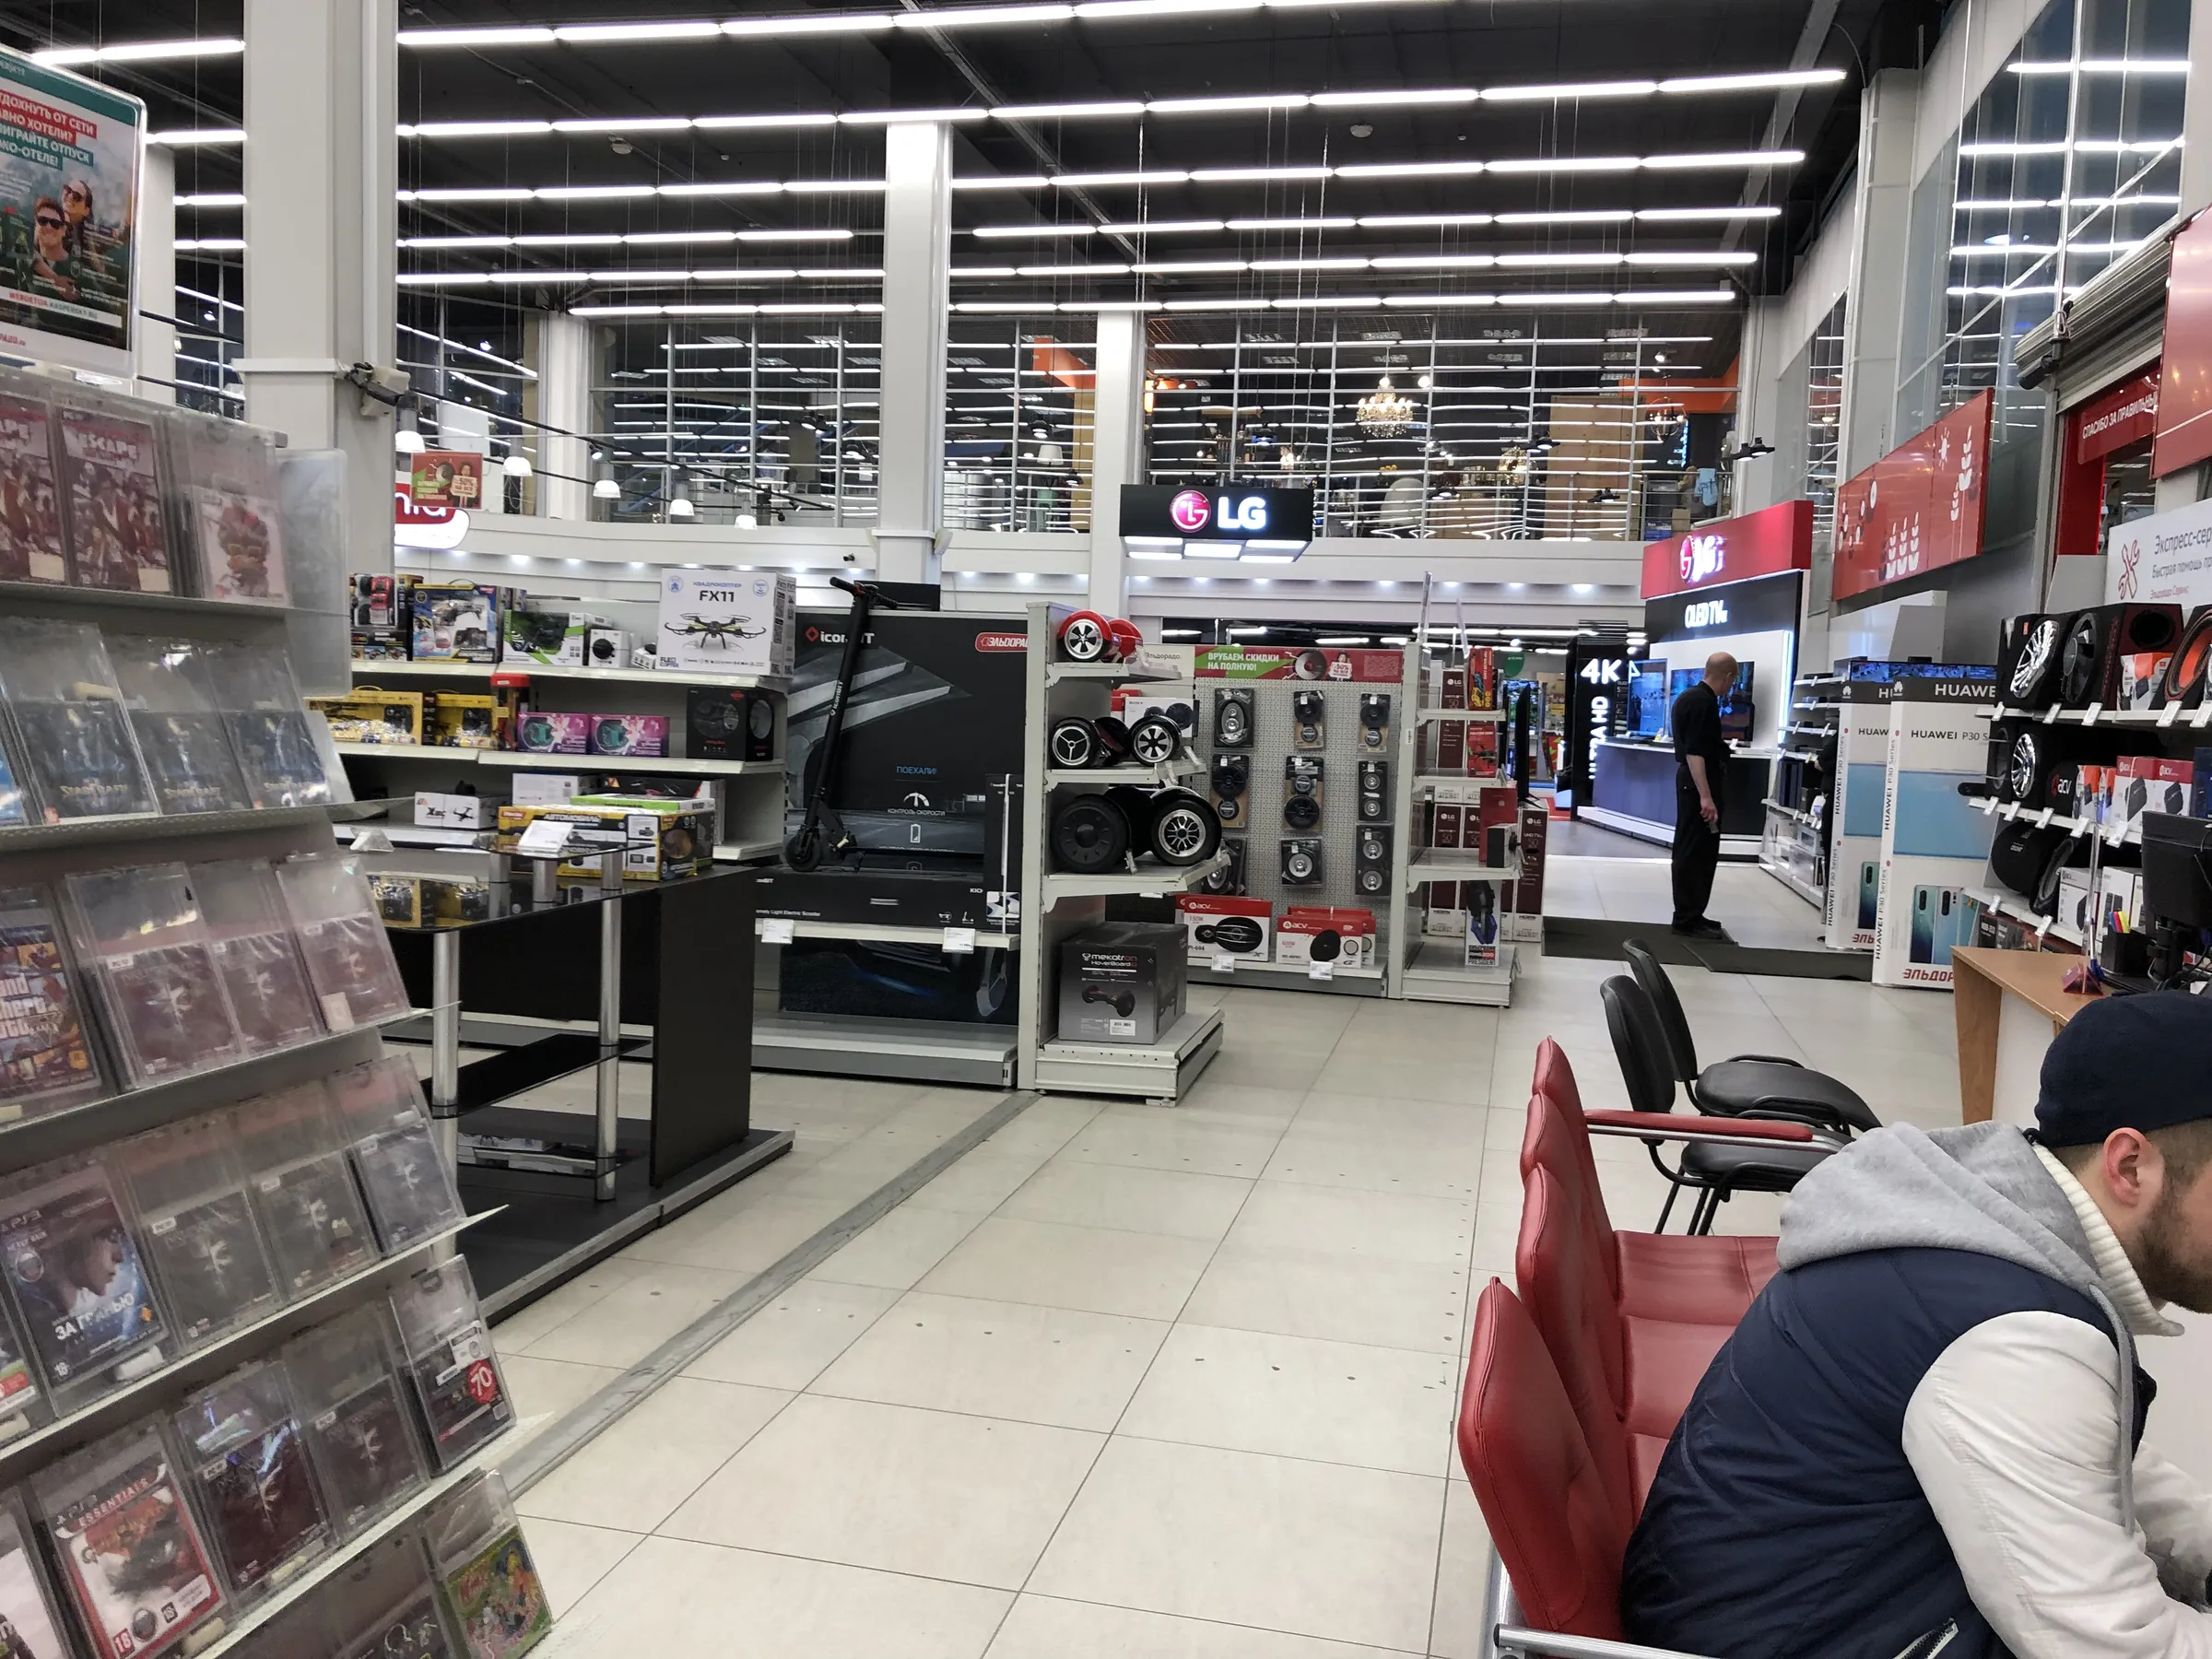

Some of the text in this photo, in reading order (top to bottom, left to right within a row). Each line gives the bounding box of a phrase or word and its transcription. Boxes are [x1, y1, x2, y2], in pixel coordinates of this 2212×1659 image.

[28, 120, 73, 142] ХОТЕЛИ?
[53, 112, 67, 124] ОТ
[69, 118, 93, 135] СЕТИ
[51, 142, 89, 163] ОТПУСК
[2083, 412, 2109, 439] СПАСИБО
[2109, 411, 2117, 427] ЗА
[1218, 496, 1267, 530] LG
[700, 590, 735, 602] FX11
[1207, 653, 1279, 662] ВРУБАЕМ СКИДКИ
[1207, 662, 1256, 671] НА ПОЛНУЮ!
[1580, 658, 1622, 684] 4K
[1591, 696, 1609, 724] HD
[1911, 730, 1957, 740] HUAWEI
[1962, 732, 1979, 741] P30
[2057, 778, 2072, 794] acv
[1884, 788, 1892, 830] HUAWEI
[1828, 889, 1836, 926] HUAWEI
[1876, 917, 1884, 959] HUAWEI
[54, 1320, 78, 1340] ЗА
[471, 1366, 493, 1397] 70
[77, 1477, 148, 1527] ESSENTIALS
[115, 1631, 134, 1653] 18
